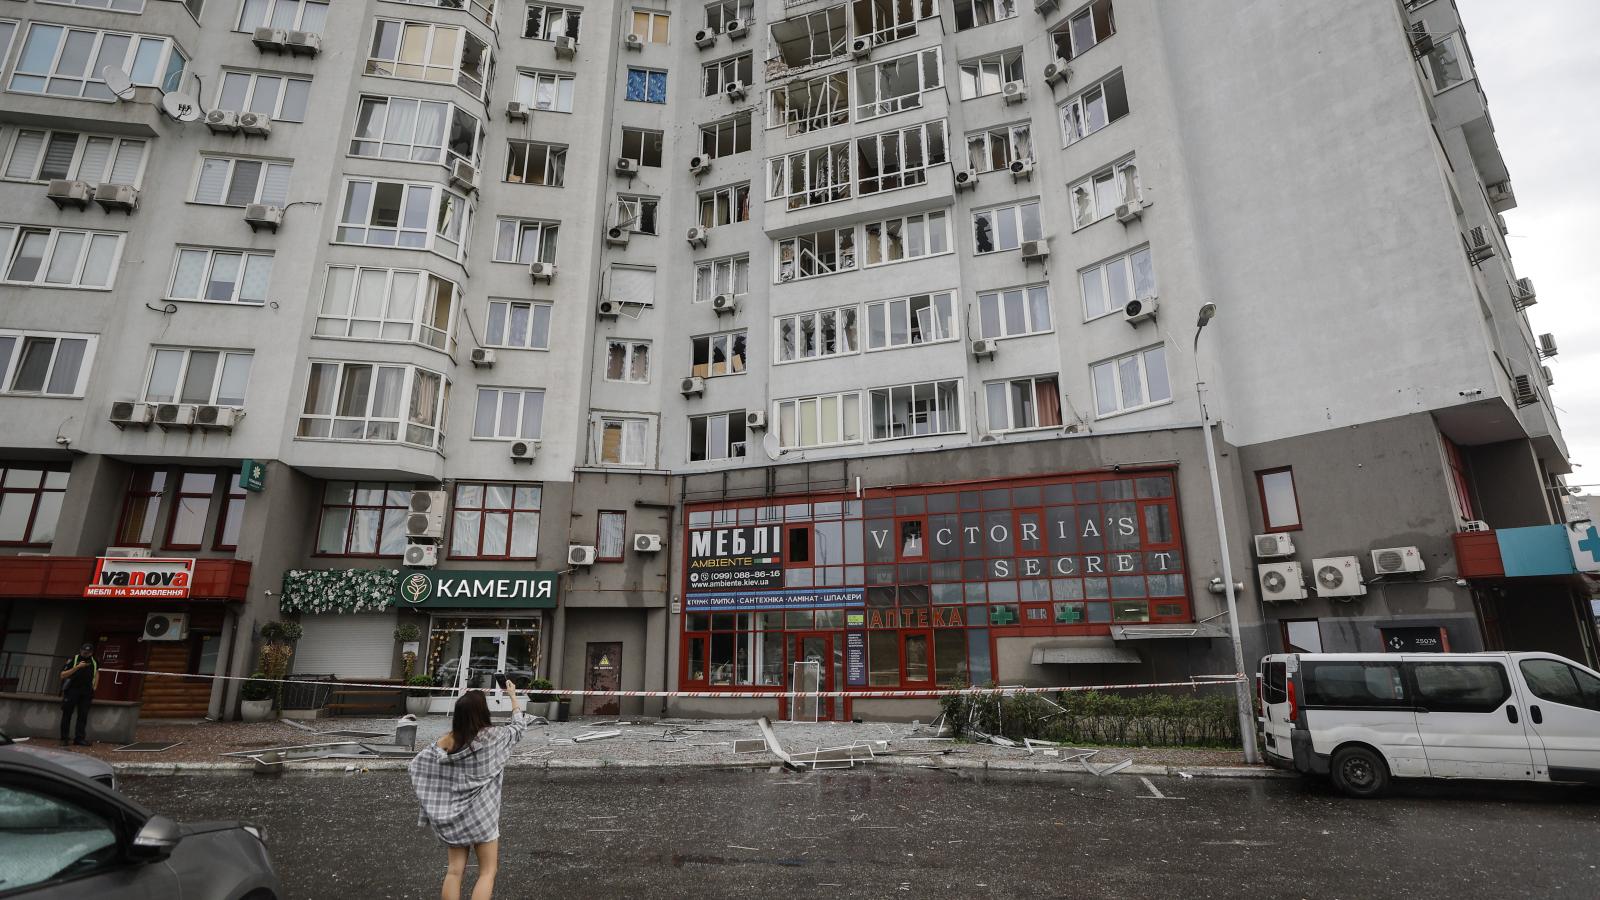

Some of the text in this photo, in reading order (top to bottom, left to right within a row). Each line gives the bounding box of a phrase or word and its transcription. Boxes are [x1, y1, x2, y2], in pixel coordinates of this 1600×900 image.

[691, 526, 780, 557] МЕБЛІ
[691, 557, 753, 568] AMBIENTE
[994, 552, 1171, 578] SECRET
[710, 571, 733, 581] (099)
[436, 579, 552, 598] КАМЕЛІЯ
[691, 579, 769, 588] www.ambiente.kiev.ua
[87, 588, 184, 597] МЕБЛІ НА ЗАМОВЛЕННЯ
[739, 596, 784, 604] САНТЕХНІКА
[787, 595, 819, 603] ЛАМІНАТ
[823, 593, 862, 602] ШПАЛЕРИ
[869, 606, 963, 629] АПТЕКА
